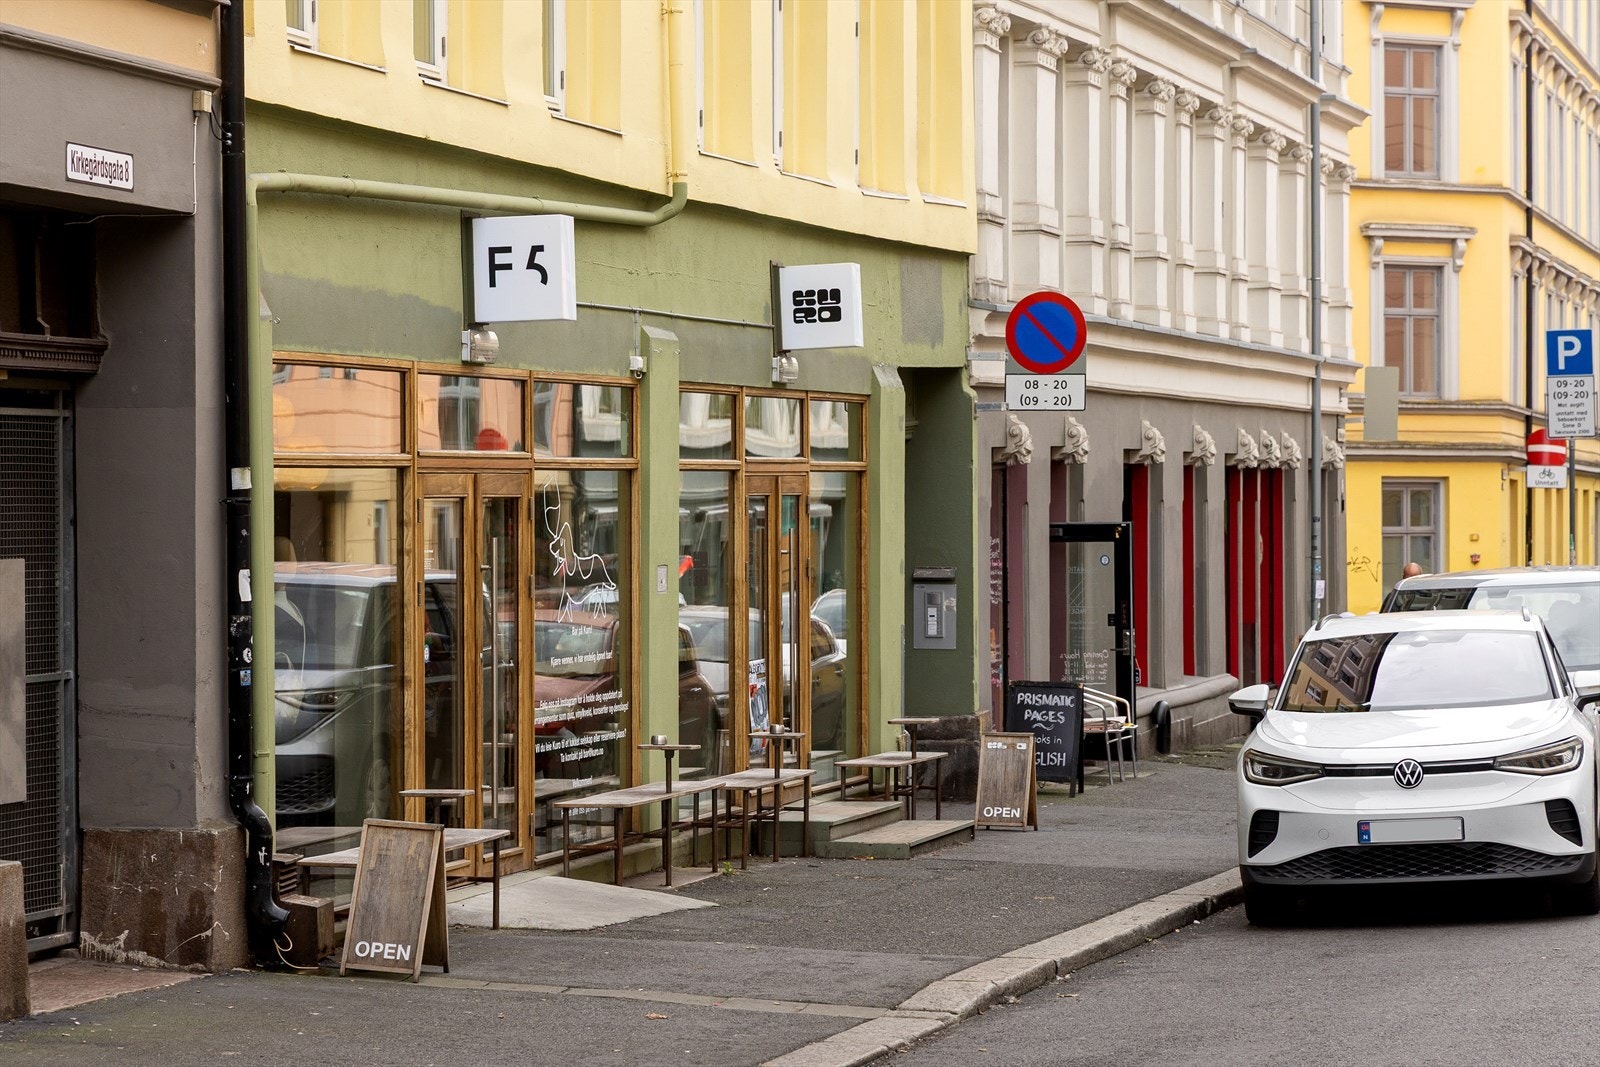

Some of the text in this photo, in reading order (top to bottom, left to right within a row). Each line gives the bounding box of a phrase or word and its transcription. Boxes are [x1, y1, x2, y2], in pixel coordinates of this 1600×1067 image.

[71, 150, 130, 184] Kirkegårdsgata 8
[1557, 336, 1582, 370] P
[1024, 380, 1039, 390] 08
[1053, 380, 1068, 390] 20
[1020, 394, 1039, 406] (09
[1053, 394, 1072, 406] 20)
[1017, 692, 1075, 708] PRISMATIC
[1024, 709, 1065, 724] PAGES
[1035, 734, 1062, 744] oks in
[1035, 752, 1066, 767] GLISH
[983, 806, 1020, 818] OPEN
[355, 940, 411, 961] OPEN
